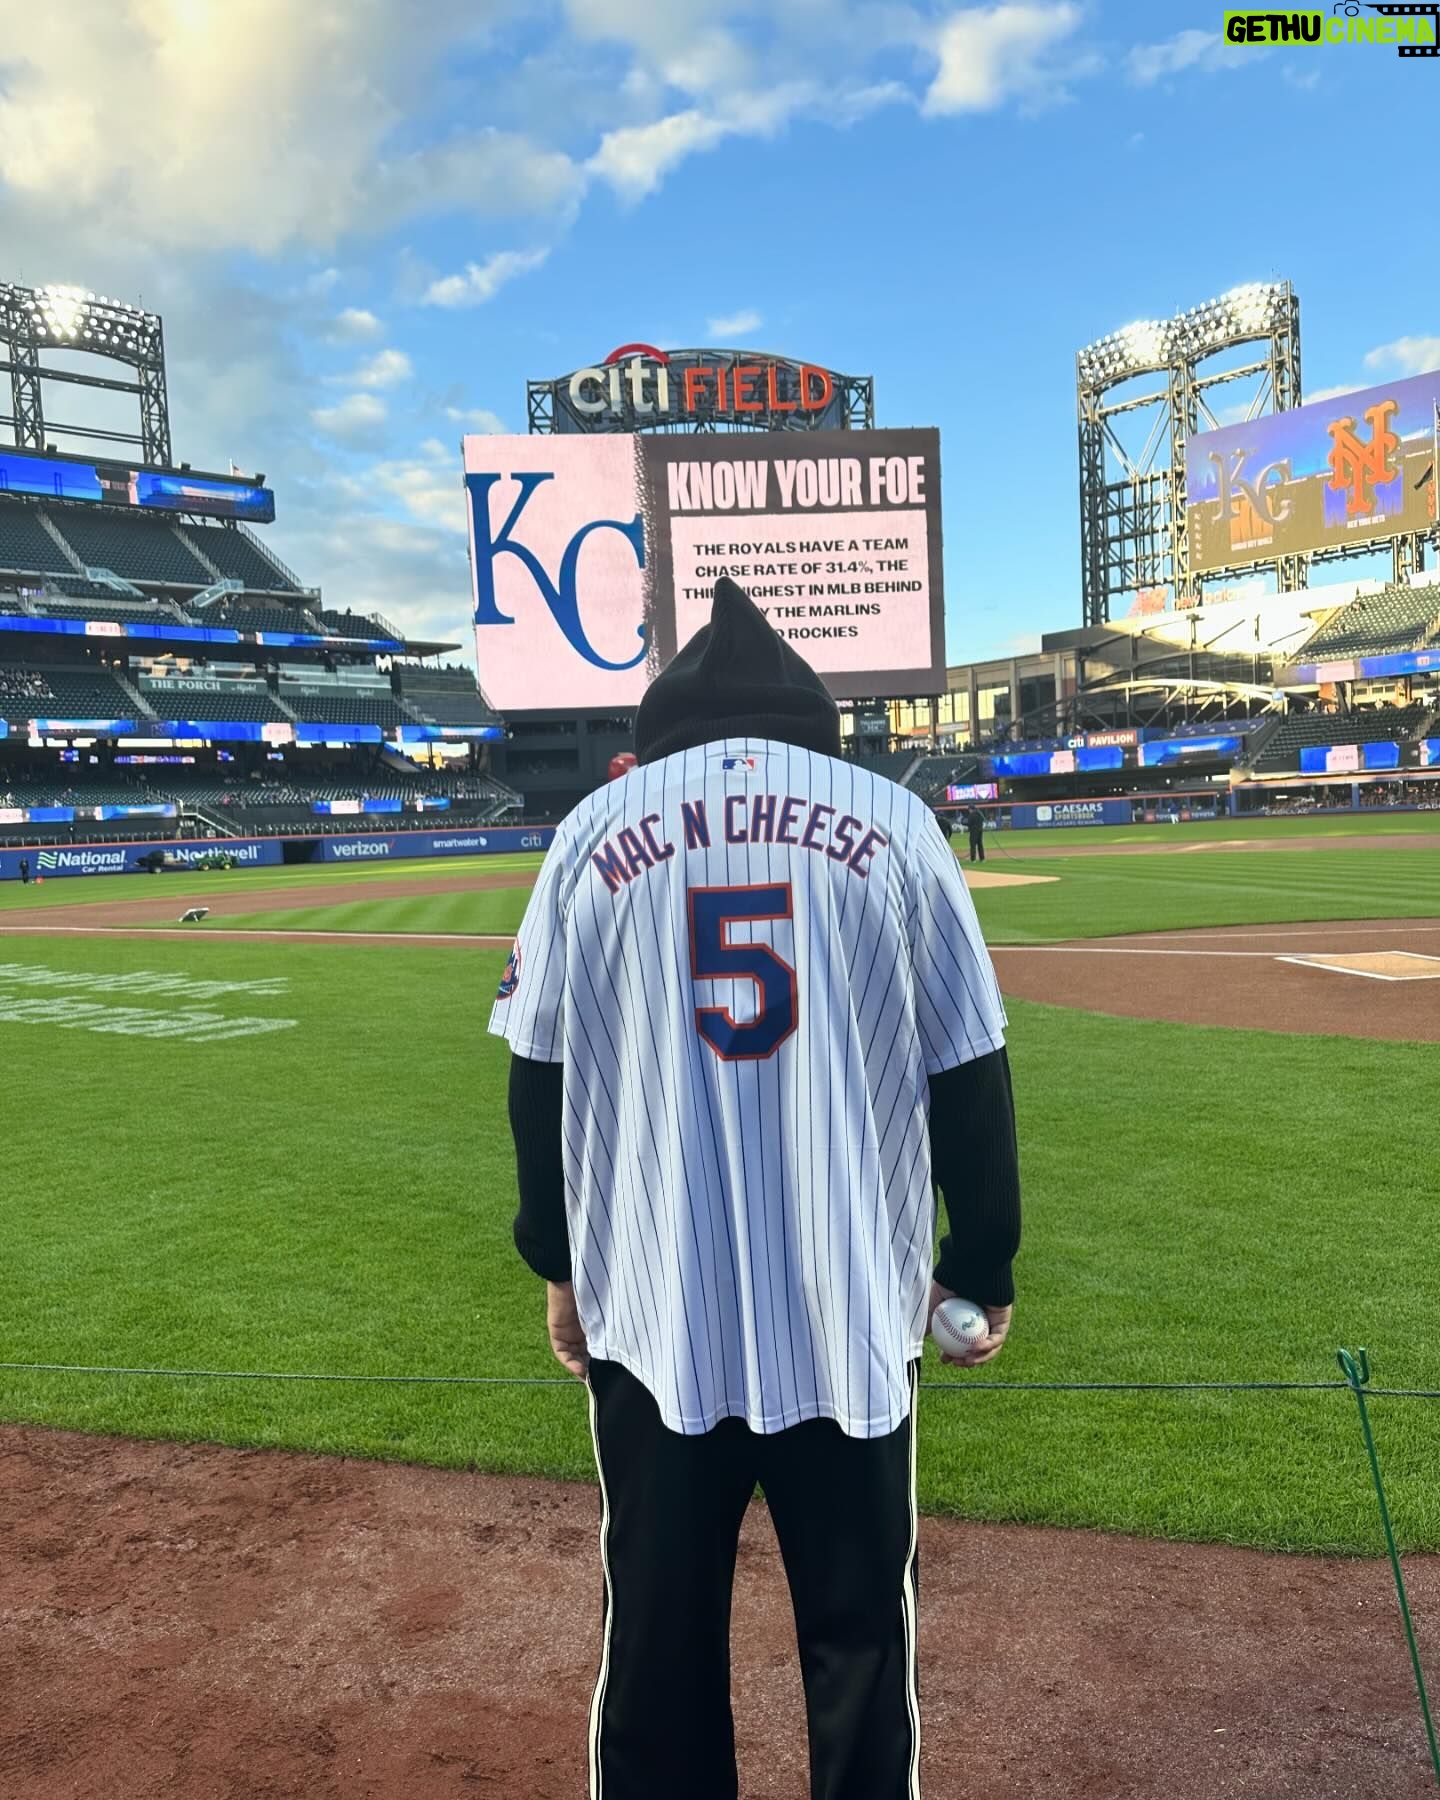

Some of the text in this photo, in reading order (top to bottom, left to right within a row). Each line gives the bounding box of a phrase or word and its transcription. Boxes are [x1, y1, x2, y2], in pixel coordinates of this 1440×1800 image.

[569, 355, 833, 413] citi FIELD
[667, 456, 926, 511] KNOW YOUR FOE
[693, 538, 909, 556] THE ROYALS HAVE A TEAM
[695, 564, 751, 578] CHASE
[754, 563, 798, 576] RATE
[801, 562, 822, 575] OF
[876, 559, 909, 572] THE
[682, 587, 715, 600] THI
[809, 583, 825, 596] IN
[827, 582, 862, 595] MLB
[864, 580, 923, 594] BEHIND
[774, 606, 806, 618] THE
[809, 603, 881, 617] MARLINS
[788, 626, 859, 640] ROCKIES
[151, 679, 174, 689] THE
[177, 680, 221, 691] PORCH
[1067, 734, 1134, 748] citi PAVILION
[1053, 803, 1104, 814] CAESARS
[433, 838, 479, 848] smartwater
[521, 834, 542, 847] citi
[592, 794, 888, 895] MAC N CHEESE
[332, 841, 389, 856] verizon
[58, 851, 126, 867] National
[688, 882, 798, 1061] 5
